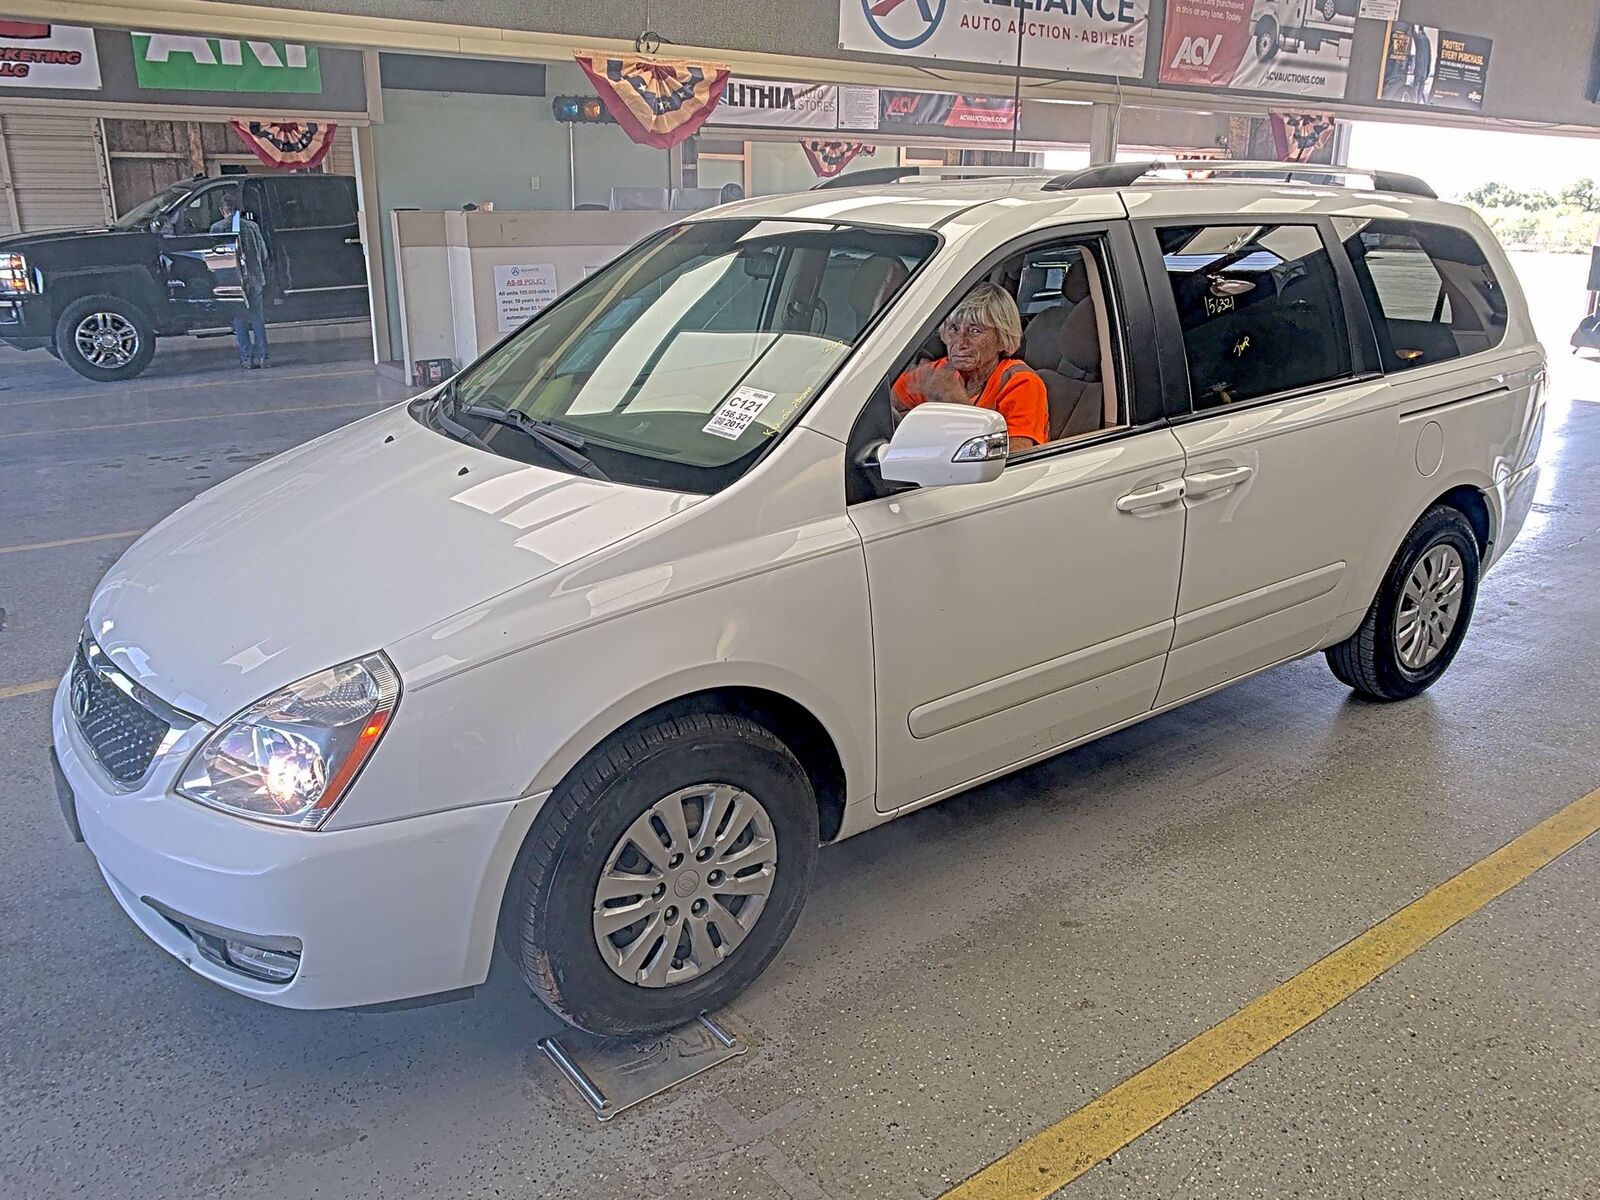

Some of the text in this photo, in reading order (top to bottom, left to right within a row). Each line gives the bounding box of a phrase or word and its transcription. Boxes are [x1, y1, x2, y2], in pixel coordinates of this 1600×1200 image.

[965, 0, 1135, 24] ANCE
[960, 14, 1001, 32] AUTO
[1007, 20, 1071, 40] AUCTION
[1081, 29, 1135, 48] ABILENE
[1170, 34, 1223, 69] ACV
[1442, 39, 1465, 52] PROTECT
[0, 63, 30, 78] LC
[728, 83, 824, 110] LITHIA AUTO
[887, 95, 921, 113] ACV
[798, 100, 835, 112] STORES
[960, 114, 1008, 124] ACVAUCTIONS.COM
[1204, 296, 1235, 316] 156321
[729, 397, 763, 413] C121
[720, 409, 753, 423] 156,321
[724, 420, 746, 430] 2014
